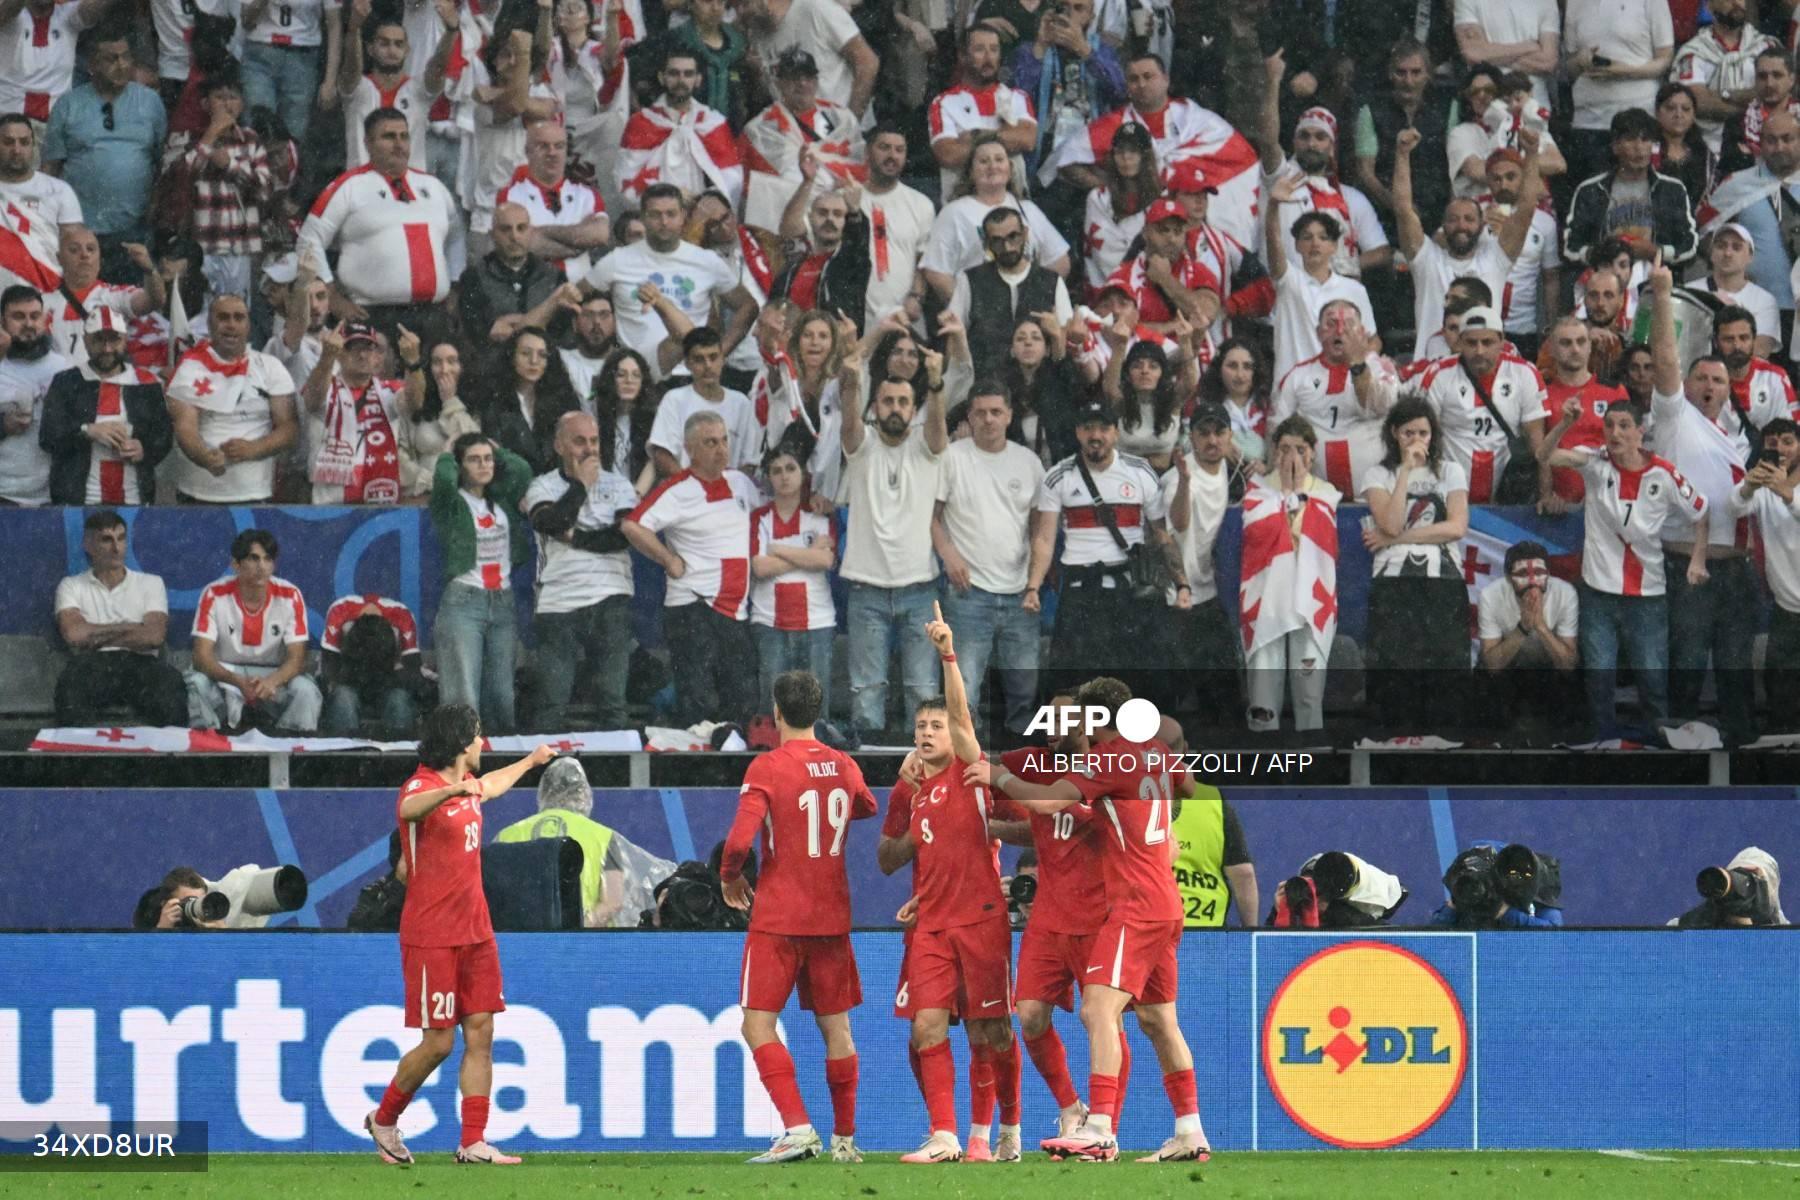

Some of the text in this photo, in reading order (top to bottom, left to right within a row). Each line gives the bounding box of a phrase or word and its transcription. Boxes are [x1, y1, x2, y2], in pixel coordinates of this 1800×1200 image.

[1330, 406, 1339, 429] 7
[1623, 503, 1633, 527] 7
[806, 761, 839, 777] YILDIZ
[798, 788, 850, 858] 19
[1138, 775, 1173, 846] 21
[920, 818, 934, 845] 8
[1052, 812, 1075, 840] 10
[1173, 866, 1219, 889] ARD
[1181, 896, 1217, 920] 24
[431, 991, 456, 1020] 20
[896, 981, 909, 1008] 6
